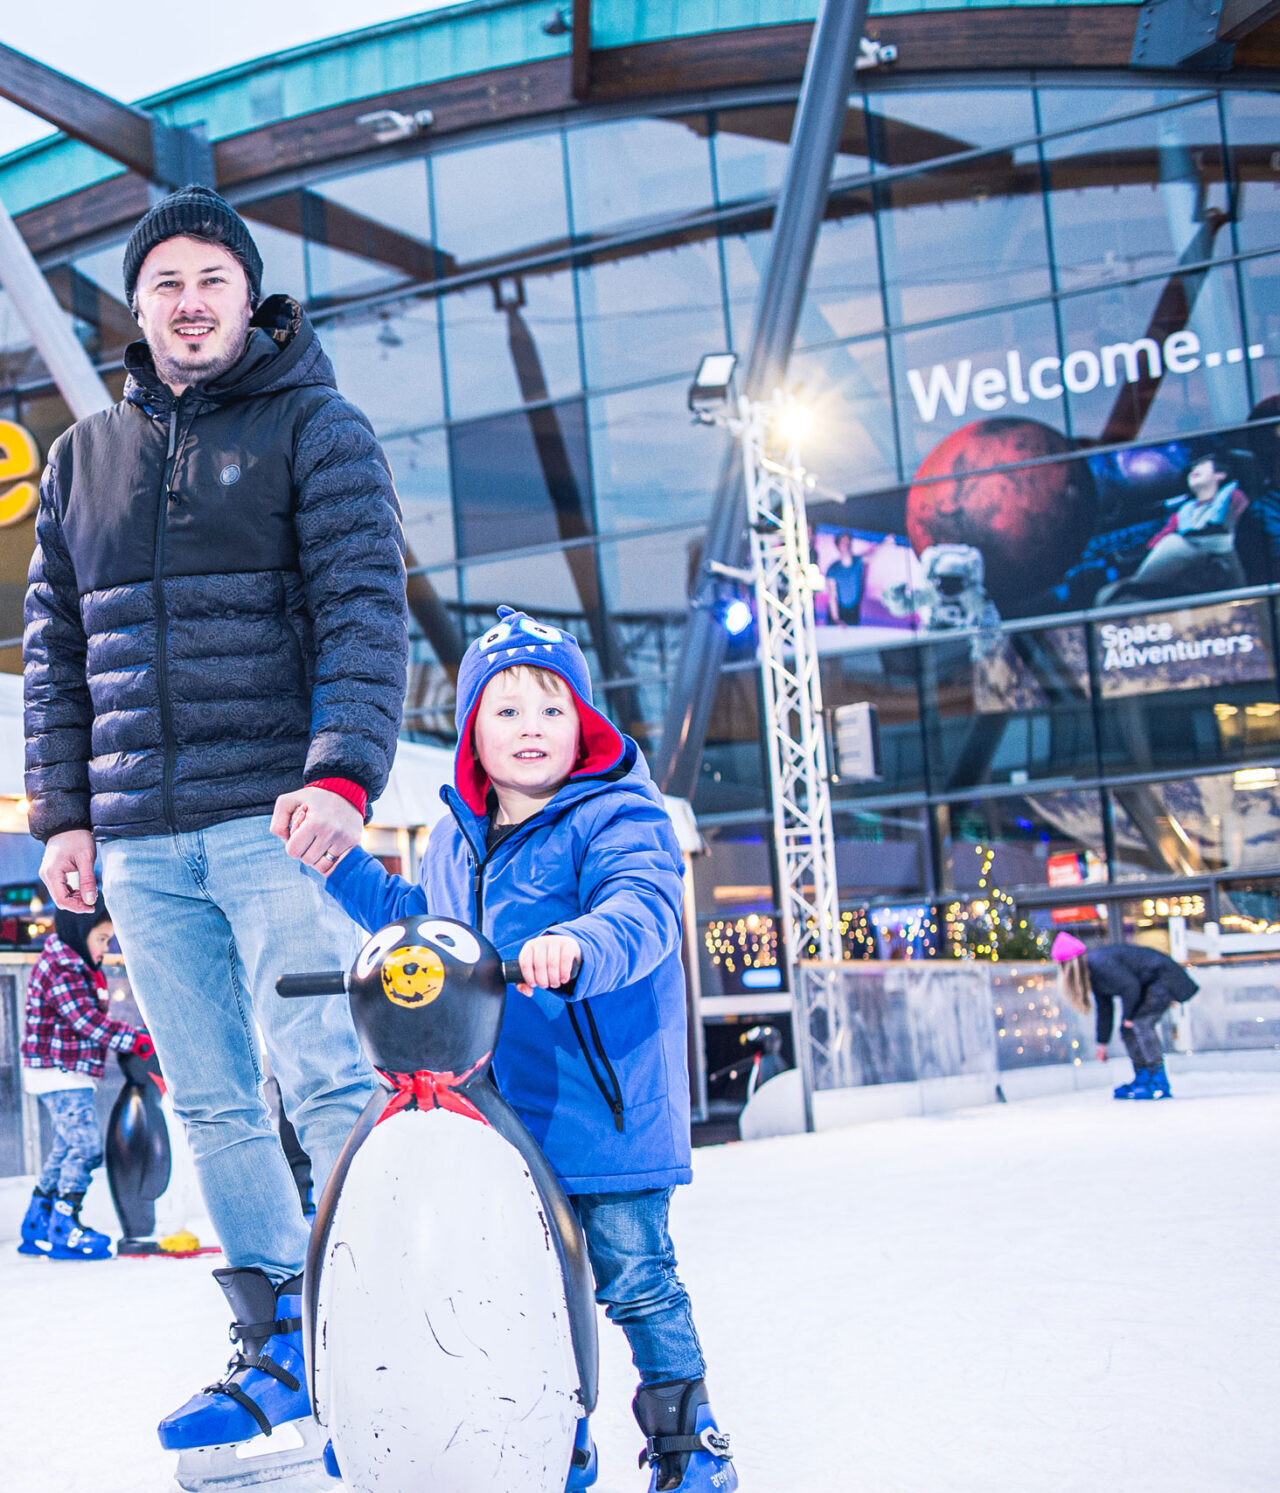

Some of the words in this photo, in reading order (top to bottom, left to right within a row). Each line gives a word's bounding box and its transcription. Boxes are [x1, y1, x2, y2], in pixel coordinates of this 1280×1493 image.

[907, 330, 1264, 423] Welcome...
[1100, 622, 1174, 652] Space
[1103, 633, 1255, 671] Adventurers
